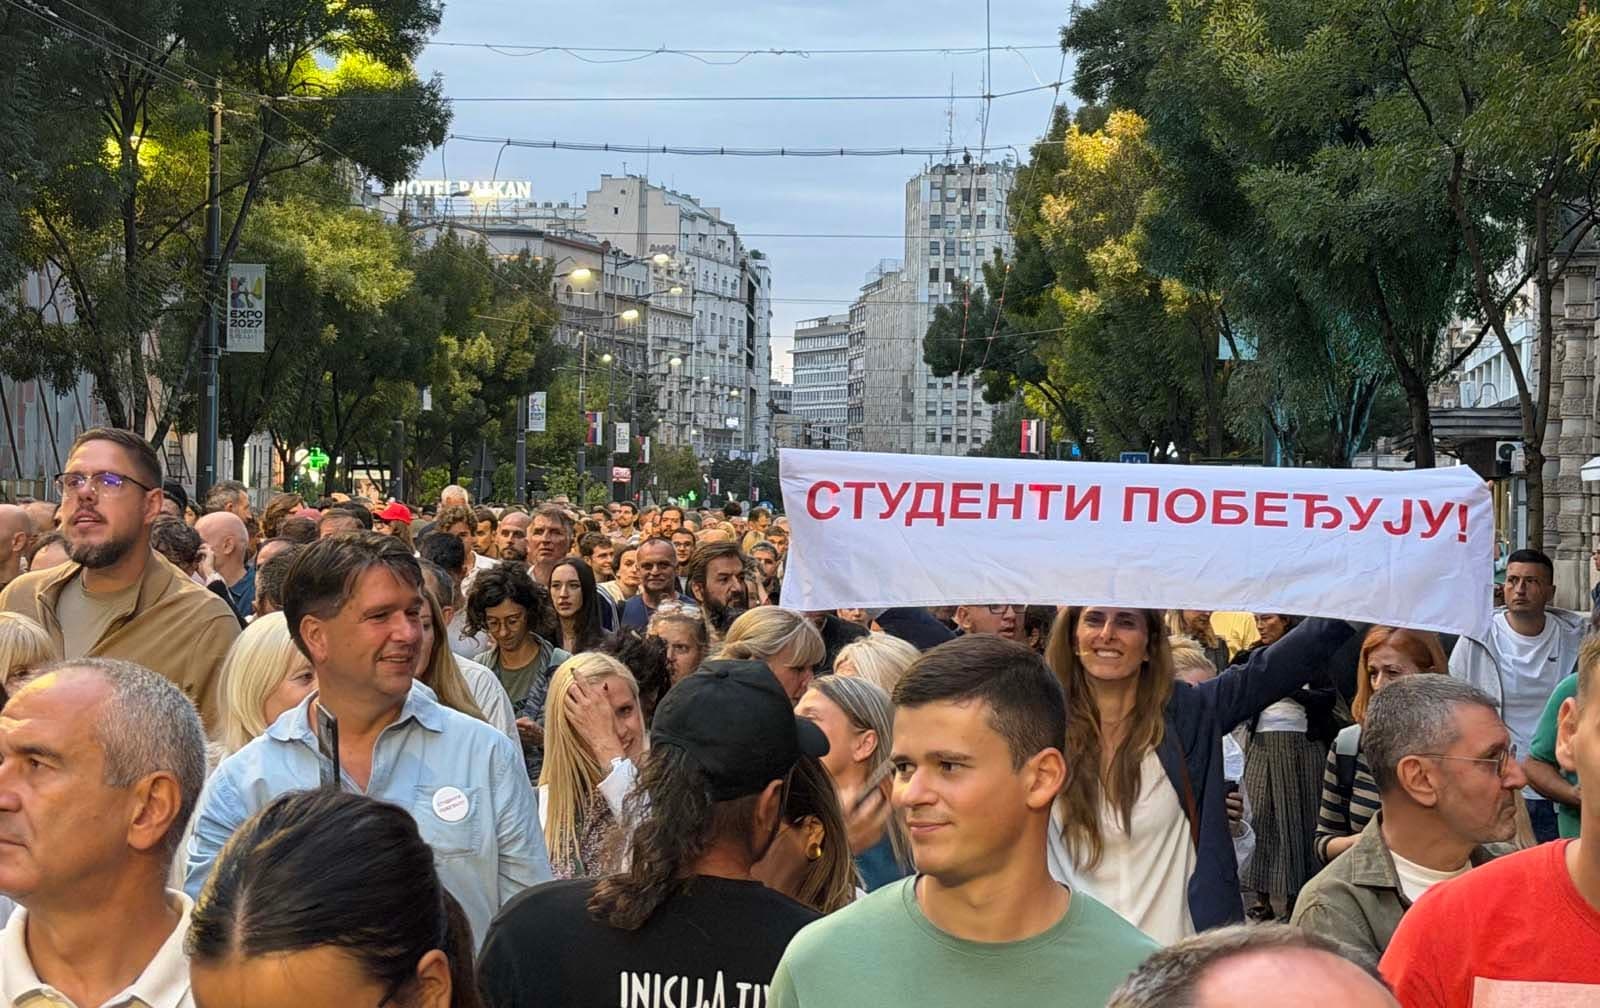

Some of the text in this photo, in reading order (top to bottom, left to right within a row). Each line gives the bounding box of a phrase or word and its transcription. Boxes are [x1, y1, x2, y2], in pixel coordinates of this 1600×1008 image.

[394, 180, 532, 198] HOTEL BALKAN
[230, 310, 263, 319] EXPO
[230, 319, 263, 328] 2027
[805, 480, 1469, 543] СТУДЕНТИ ПОБЕЂУЈУ!
